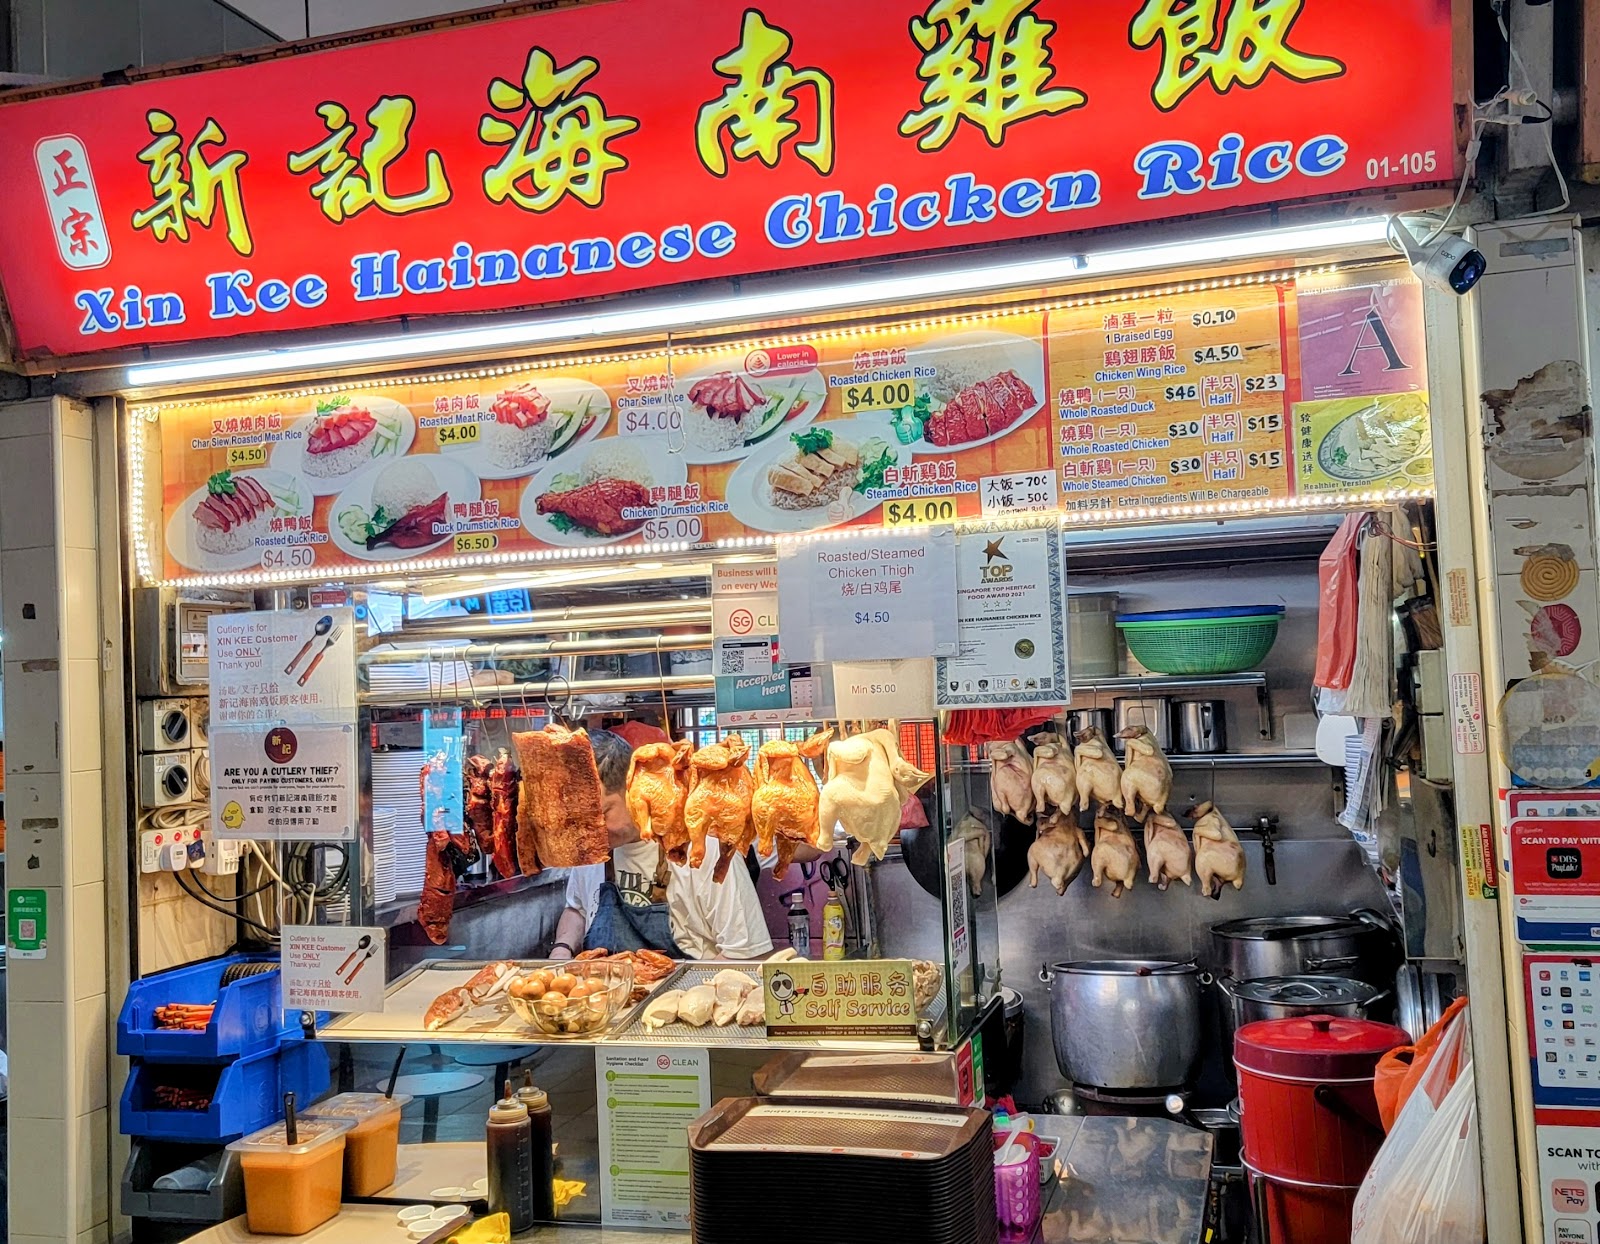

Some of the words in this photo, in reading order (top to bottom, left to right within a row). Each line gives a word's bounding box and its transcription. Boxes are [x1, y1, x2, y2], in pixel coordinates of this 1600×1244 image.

[1366, 149, 1437, 181] 01-105
[49, 148, 100, 258] 正宗
[77, 289, 187, 335] Xin
[208, 269, 328, 320] Kee
[354, 220, 737, 302] Hainanese
[764, 170, 1100, 248] Chicken
[1135, 133, 1348, 200] Rice
[1105, 335, 1110, 344] 1
[1114, 330, 1151, 343] Braised
[1153, 328, 1173, 340] Egg
[1338, 306, 1414, 377] A
[777, 352, 801, 361] Lower
[802, 350, 809, 358] in
[1194, 345, 1239, 364] $4.50
[830, 373, 869, 386] Roasted
[872, 370, 911, 382] Chicken
[914, 366, 936, 377] Rice
[1095, 369, 1134, 382] Chicken
[1136, 366, 1161, 378] Wing
[1164, 364, 1186, 375] Rice
[1246, 375, 1278, 392] $23
[847, 383, 910, 410] $4.00
[1165, 385, 1196, 400] $46
[1209, 393, 1232, 404] Half
[618, 397, 639, 408] Char
[641, 395, 662, 405] Siew
[1060, 409, 1088, 419] Whole
[1091, 404, 1128, 416] Roasted
[1130, 401, 1154, 413] Duck
[420, 415, 453, 427] Roasted
[456, 413, 475, 423] Meat
[477, 412, 496, 422] Rice
[626, 411, 681, 433] $4.00
[1248, 415, 1279, 431] $15
[439, 425, 476, 443] $4.00
[1169, 421, 1199, 438] $30
[1211, 431, 1234, 443] Half
[192, 439, 209, 448] Char
[212, 438, 229, 447] Siew
[231, 434, 262, 445] Roasted
[265, 433, 283, 442] Meat
[285, 430, 302, 440] Rice
[1062, 446, 1089, 456] Whole
[1092, 441, 1129, 453] Roasted
[1132, 438, 1169, 449] Chicken
[231, 449, 262, 463] $4.50
[1249, 451, 1280, 467] $15
[1170, 458, 1201, 474] $30
[1213, 468, 1236, 479] Half
[866, 487, 909, 499] Steamed
[911, 484, 951, 496] Chicken
[955, 481, 977, 492] Rice
[1063, 481, 1090, 491] Whole
[1091, 477, 1129, 490] Steamed
[1131, 475, 1167, 486] Chicken
[1341, 480, 1371, 488] Version
[1118, 497, 1139, 507] Extra
[1142, 493, 1187, 507] Ingredients
[1190, 490, 1205, 501] Will
[1207, 490, 1218, 499] Be
[1221, 487, 1269, 499] Chargeable
[623, 509, 658, 518] Chicken
[661, 503, 706, 516] Drumstick
[709, 502, 729, 512] Rice
[889, 501, 953, 525] $4.00
[433, 523, 455, 533] Duck
[456, 520, 498, 531] Drumstick
[500, 518, 519, 528] Rice
[645, 518, 700, 542] $5.00
[254, 535, 286, 547] Roasted
[288, 534, 308, 544] Duck
[311, 533, 327, 542] Rice
[457, 538, 490, 552] $6.50
[263, 549, 313, 569] $4.50
[817, 547, 925, 563] Roasted/Steamed
[717, 568, 754, 578] Business
[756, 567, 771, 576] will
[828, 566, 877, 579] Chicken
[880, 564, 914, 577] Thigh
[980, 565, 1013, 578] TOP
[721, 582, 733, 590] on
[735, 581, 758, 591] every
[981, 576, 1013, 584] AWARDS
[733, 616, 751, 627] SG
[855, 611, 890, 625] $4.50
[217, 625, 245, 635] Cutlery
[248, 624, 254, 632] is
[257, 624, 267, 632] for
[217, 637, 232, 646] XIN
[235, 636, 252, 645] KEE
[255, 634, 298, 644] Customer
[217, 650, 233, 658] Use
[218, 661, 242, 670] Thank
[246, 659, 262, 670] you!
[736, 670, 785, 689] Accepted
[762, 683, 786, 696] here
[852, 685, 868, 694] Min
[870, 683, 896, 694] $5.00
[224, 768, 240, 776] ARE
[243, 767, 259, 776] YOU
[262, 767, 268, 775] A
[271, 766, 307, 775] CUTLERY
[311, 766, 339, 775] THIEF?
[1521, 837, 1546, 845] SCAN
[1548, 837, 1560, 845] TO
[1562, 837, 1579, 845] PAY
[1559, 855, 1577, 863] DBS
[811, 971, 909, 997] 自助服务
[806, 999, 842, 1020] Self
[846, 998, 910, 1017] Service
[1547, 1148, 1582, 1158] SCAN
[1555, 1188, 1585, 1196] NETS
[1566, 1196, 1585, 1206] Pay
